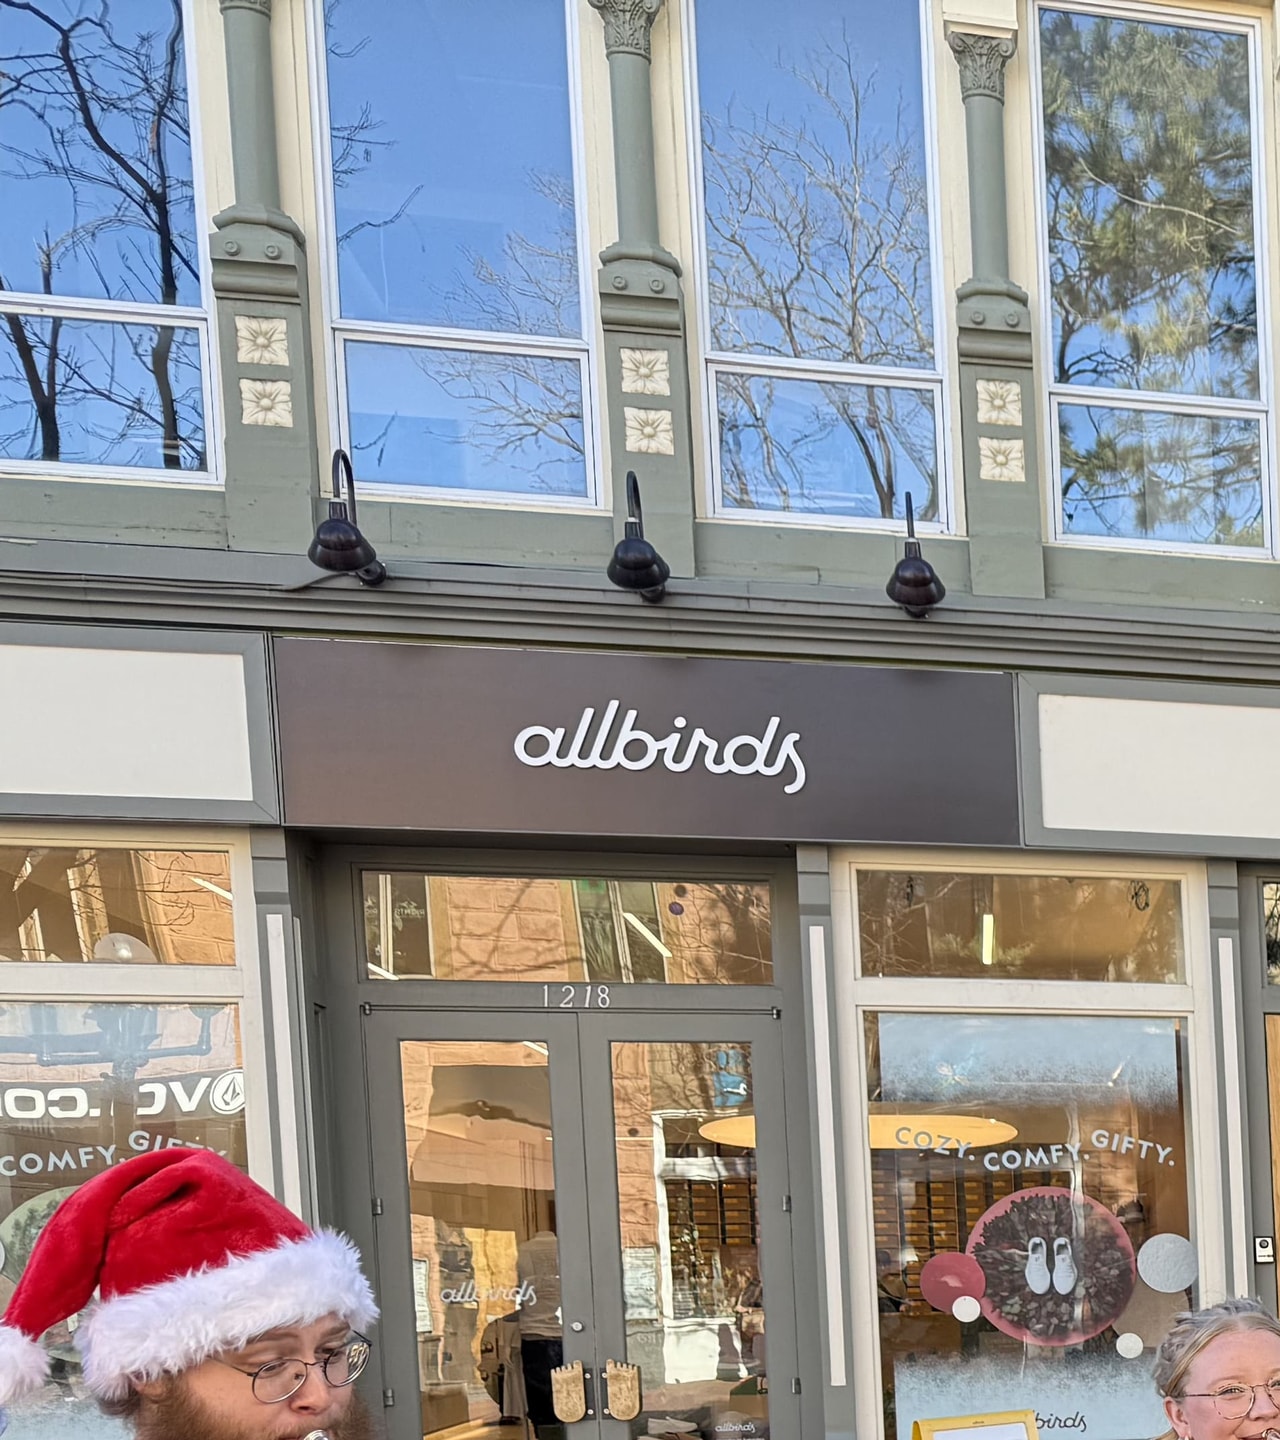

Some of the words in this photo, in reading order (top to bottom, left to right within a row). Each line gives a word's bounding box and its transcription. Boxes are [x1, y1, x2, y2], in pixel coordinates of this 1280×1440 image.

[514, 699, 807, 794] allbirds
[542, 984, 611, 1009] 1218
[895, 1127, 975, 1161] COZY.
[983, 1142, 1090, 1171] COMFY.
[1090, 1129, 1175, 1167] GIFTY.
